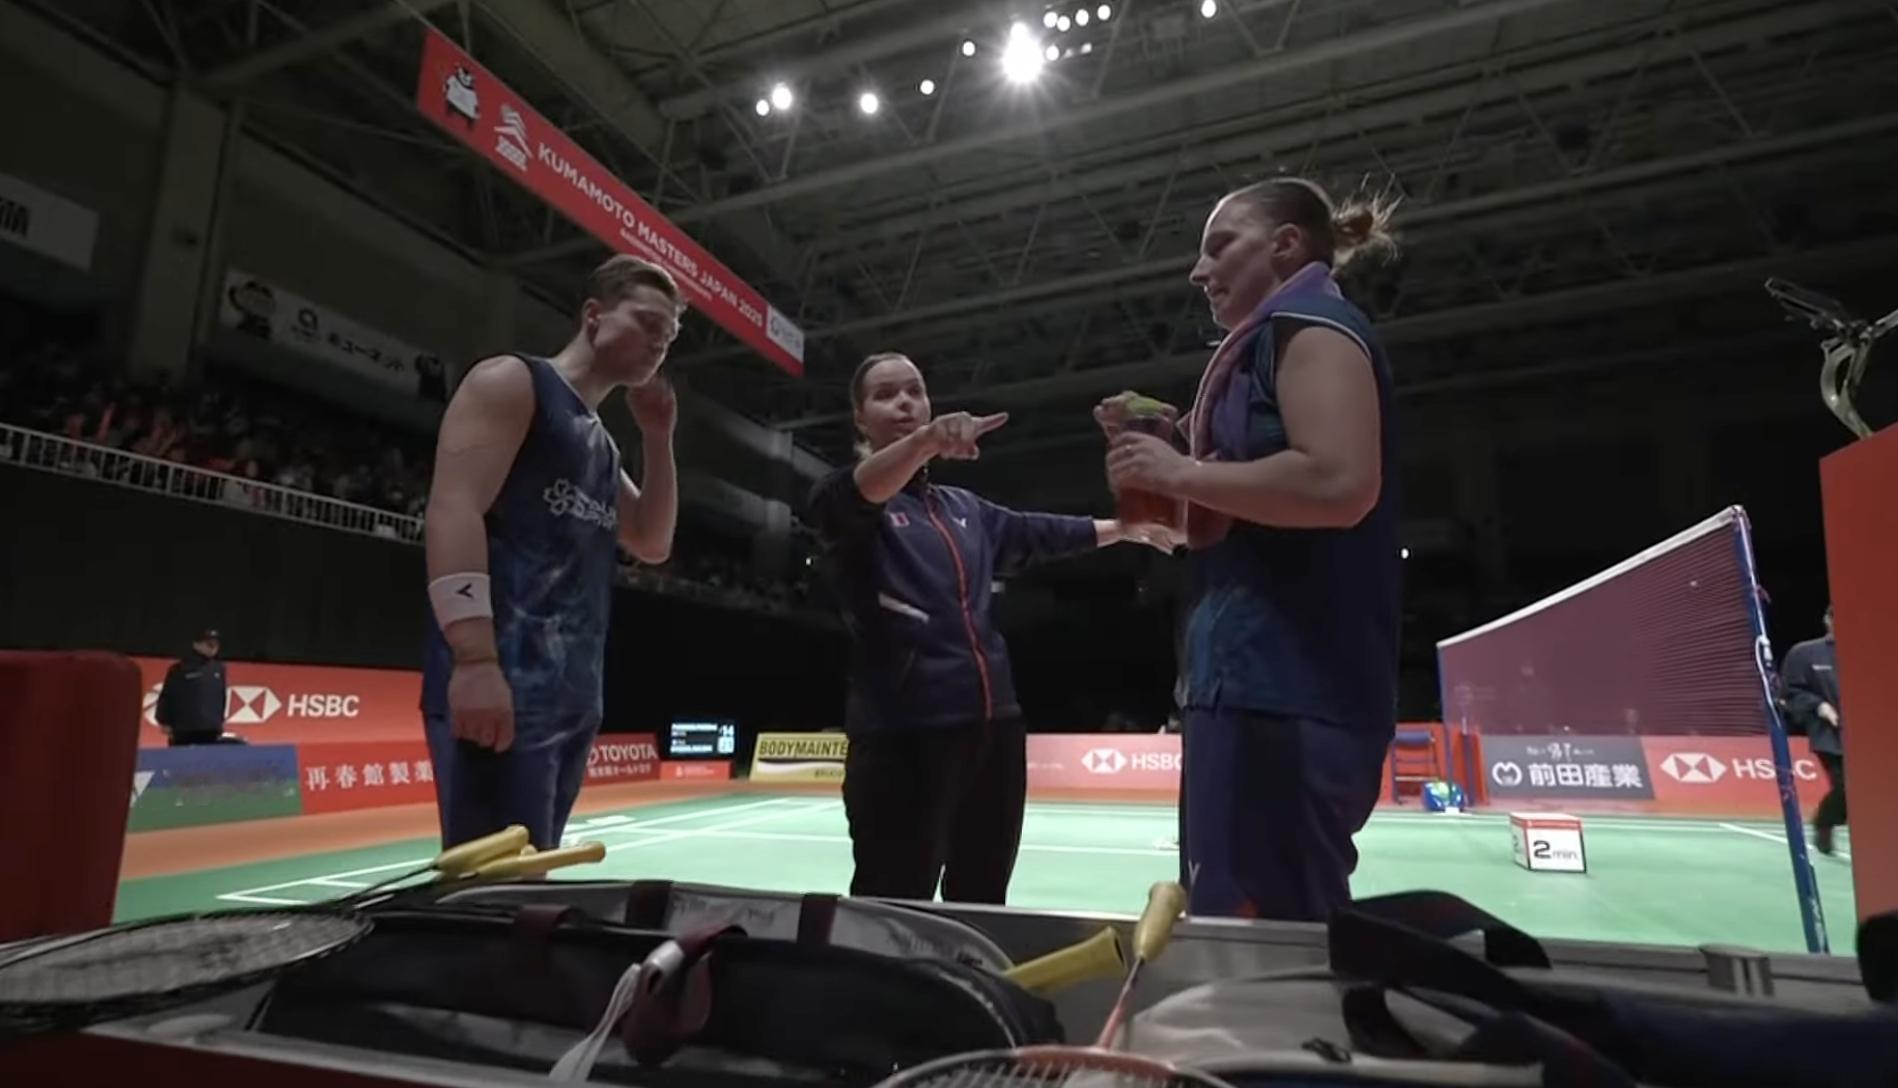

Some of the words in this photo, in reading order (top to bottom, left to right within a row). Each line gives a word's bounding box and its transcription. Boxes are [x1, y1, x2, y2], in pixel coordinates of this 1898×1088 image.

[538, 142, 635, 228] KUMAMOTO
[637, 222, 699, 277] MASTERS
[699, 270, 738, 307] JAPAN
[287, 693, 359, 718] HSBC
[598, 743, 659, 762] TOYOTA
[305, 761, 434, 791] 再春館製薬
[1527, 762, 1643, 788] 前田産業
[1732, 759, 1817, 779] HSC
[1532, 839, 1551, 859] 2
